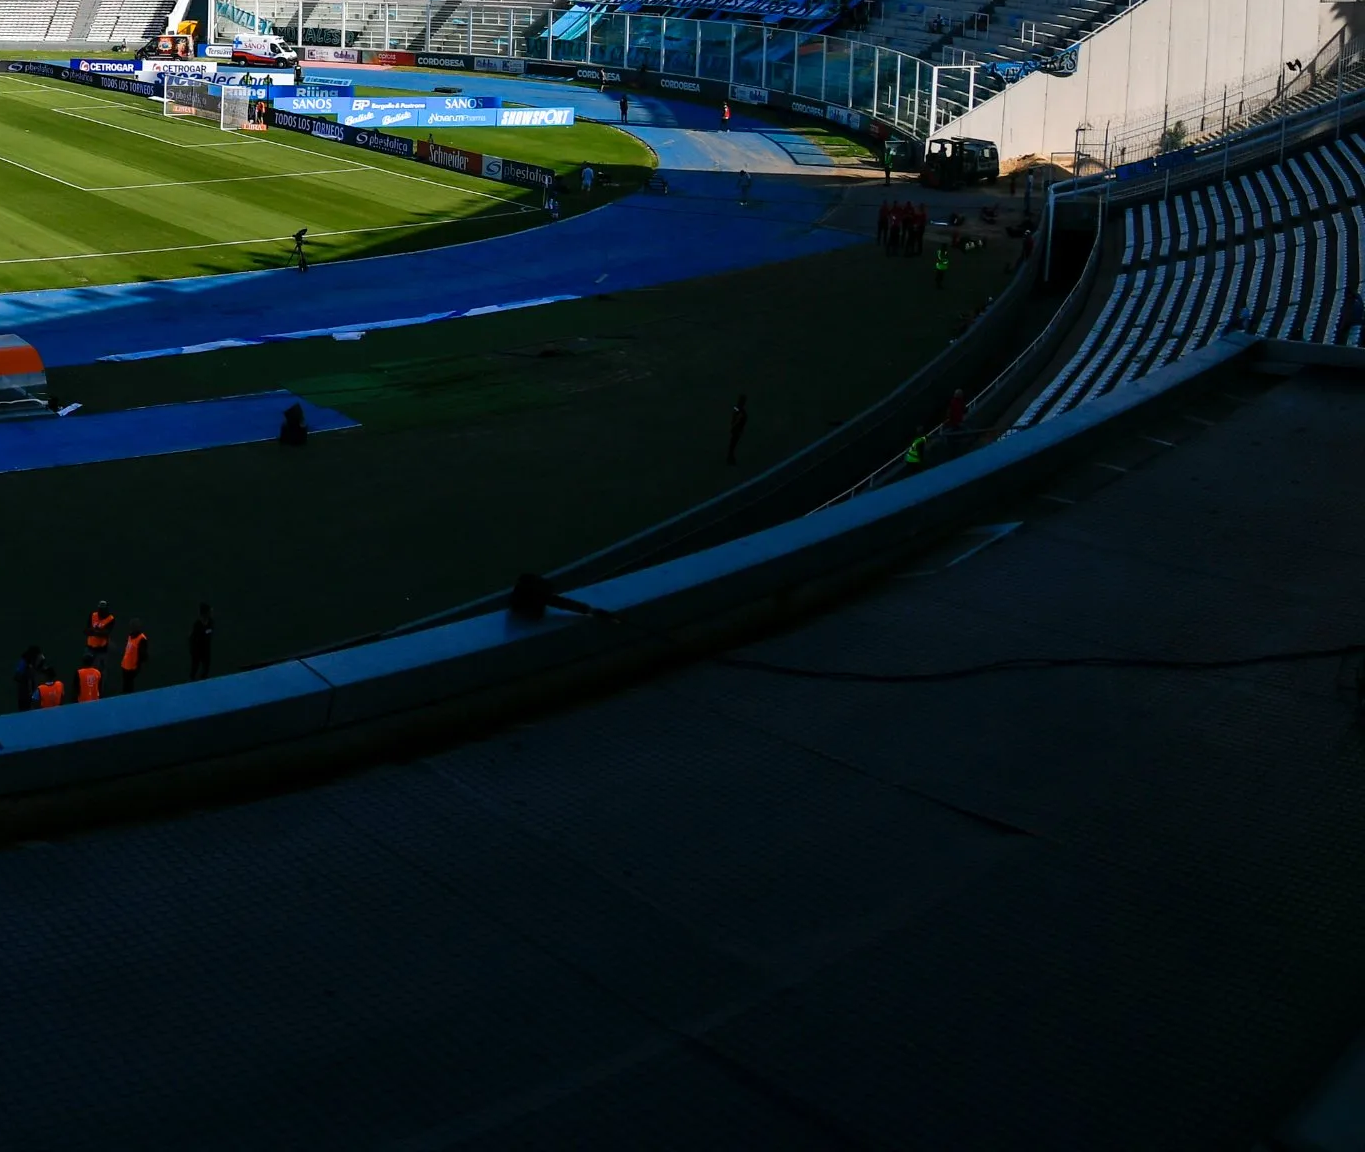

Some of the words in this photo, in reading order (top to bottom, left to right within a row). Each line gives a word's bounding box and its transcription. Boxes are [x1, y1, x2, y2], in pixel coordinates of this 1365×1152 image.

[243, 42, 266, 50] SANOS
[90, 62, 135, 72] CETROGAR
[162, 64, 207, 73] CETROGAR
[417, 56, 465, 68] CORDOBESA
[576, 69, 621, 82] CORDESA
[100, 76, 118, 90] TODOS
[118, 78, 129, 91] LOS
[129, 79, 155, 96] TORNEOS
[660, 78, 701, 93] CORDOBESA
[292, 98, 333, 110] SANOS
[445, 98, 484, 109] SANOS
[500, 109, 570, 126] SHOWSPORT
[274, 112, 297, 130] TODOS
[298, 117, 311, 132] LOS
[312, 120, 344, 141] TORNEOS
[369, 133, 408, 152] pbestatica
[428, 143, 470, 171] Schneider
